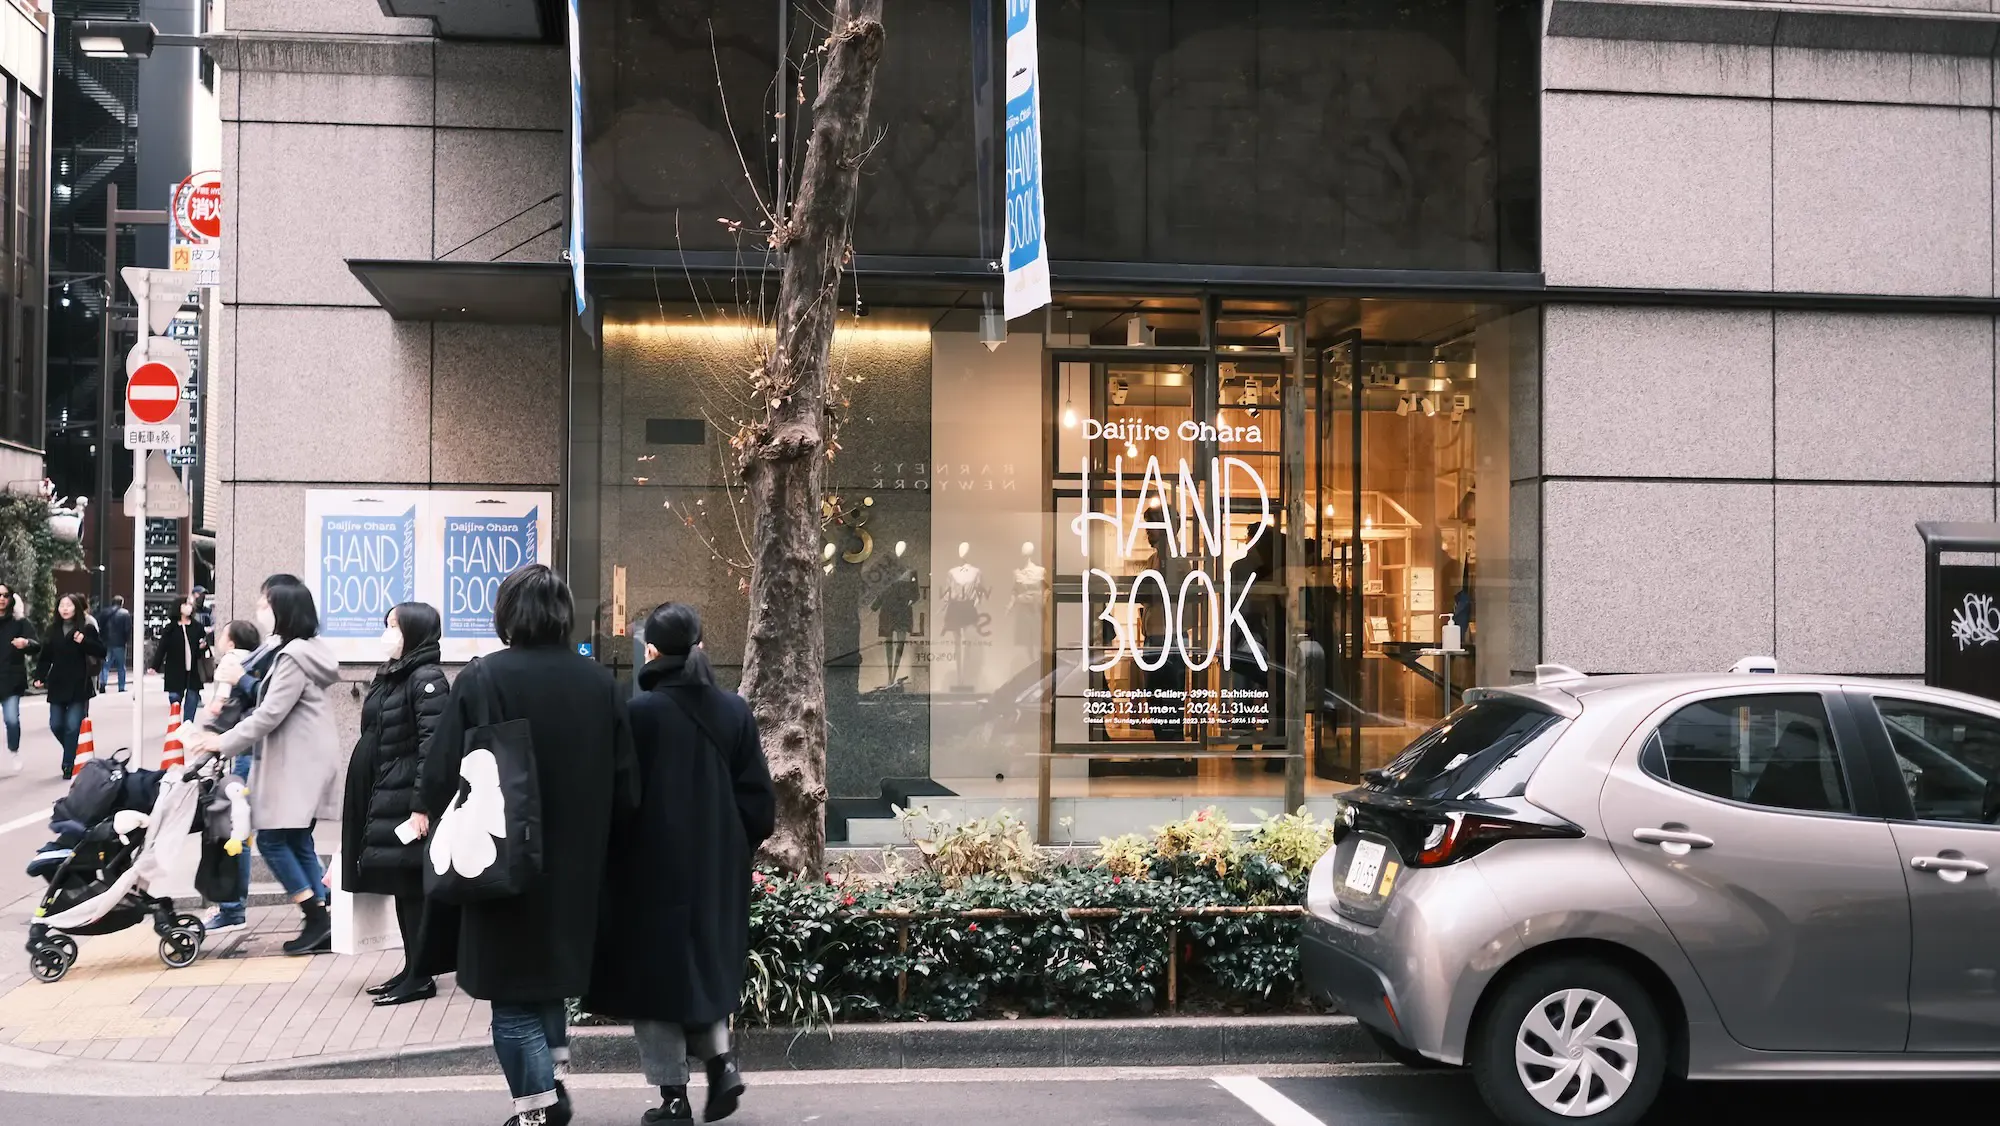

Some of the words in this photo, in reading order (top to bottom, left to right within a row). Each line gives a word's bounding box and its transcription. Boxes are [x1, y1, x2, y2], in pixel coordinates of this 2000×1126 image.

[1008, 186, 1038, 253] BOOK
[192, 249, 220, 261] 皮フ
[129, 430, 175, 444] 自転車を除く
[1081, 417, 1170, 447] Daijiro
[1177, 420, 1263, 443] Ohara
[1071, 455, 1269, 559] HAND
[327, 521, 361, 532] Daijiro
[363, 522, 396, 531] Ohara
[450, 522, 484, 533] Daijiro
[486, 523, 518, 532] Ohara
[323, 534, 399, 572] HAND
[446, 535, 521, 573] HAND
[326, 575, 395, 613] BOOK
[1081, 568, 1269, 672] BOOK
[1083, 688, 1111, 698] Ginza
[1113, 688, 1152, 699] Graphic
[1154, 688, 1188, 701] Gallery
[1190, 688, 1218, 698] 399th
[1221, 688, 1269, 698] Exhibition
